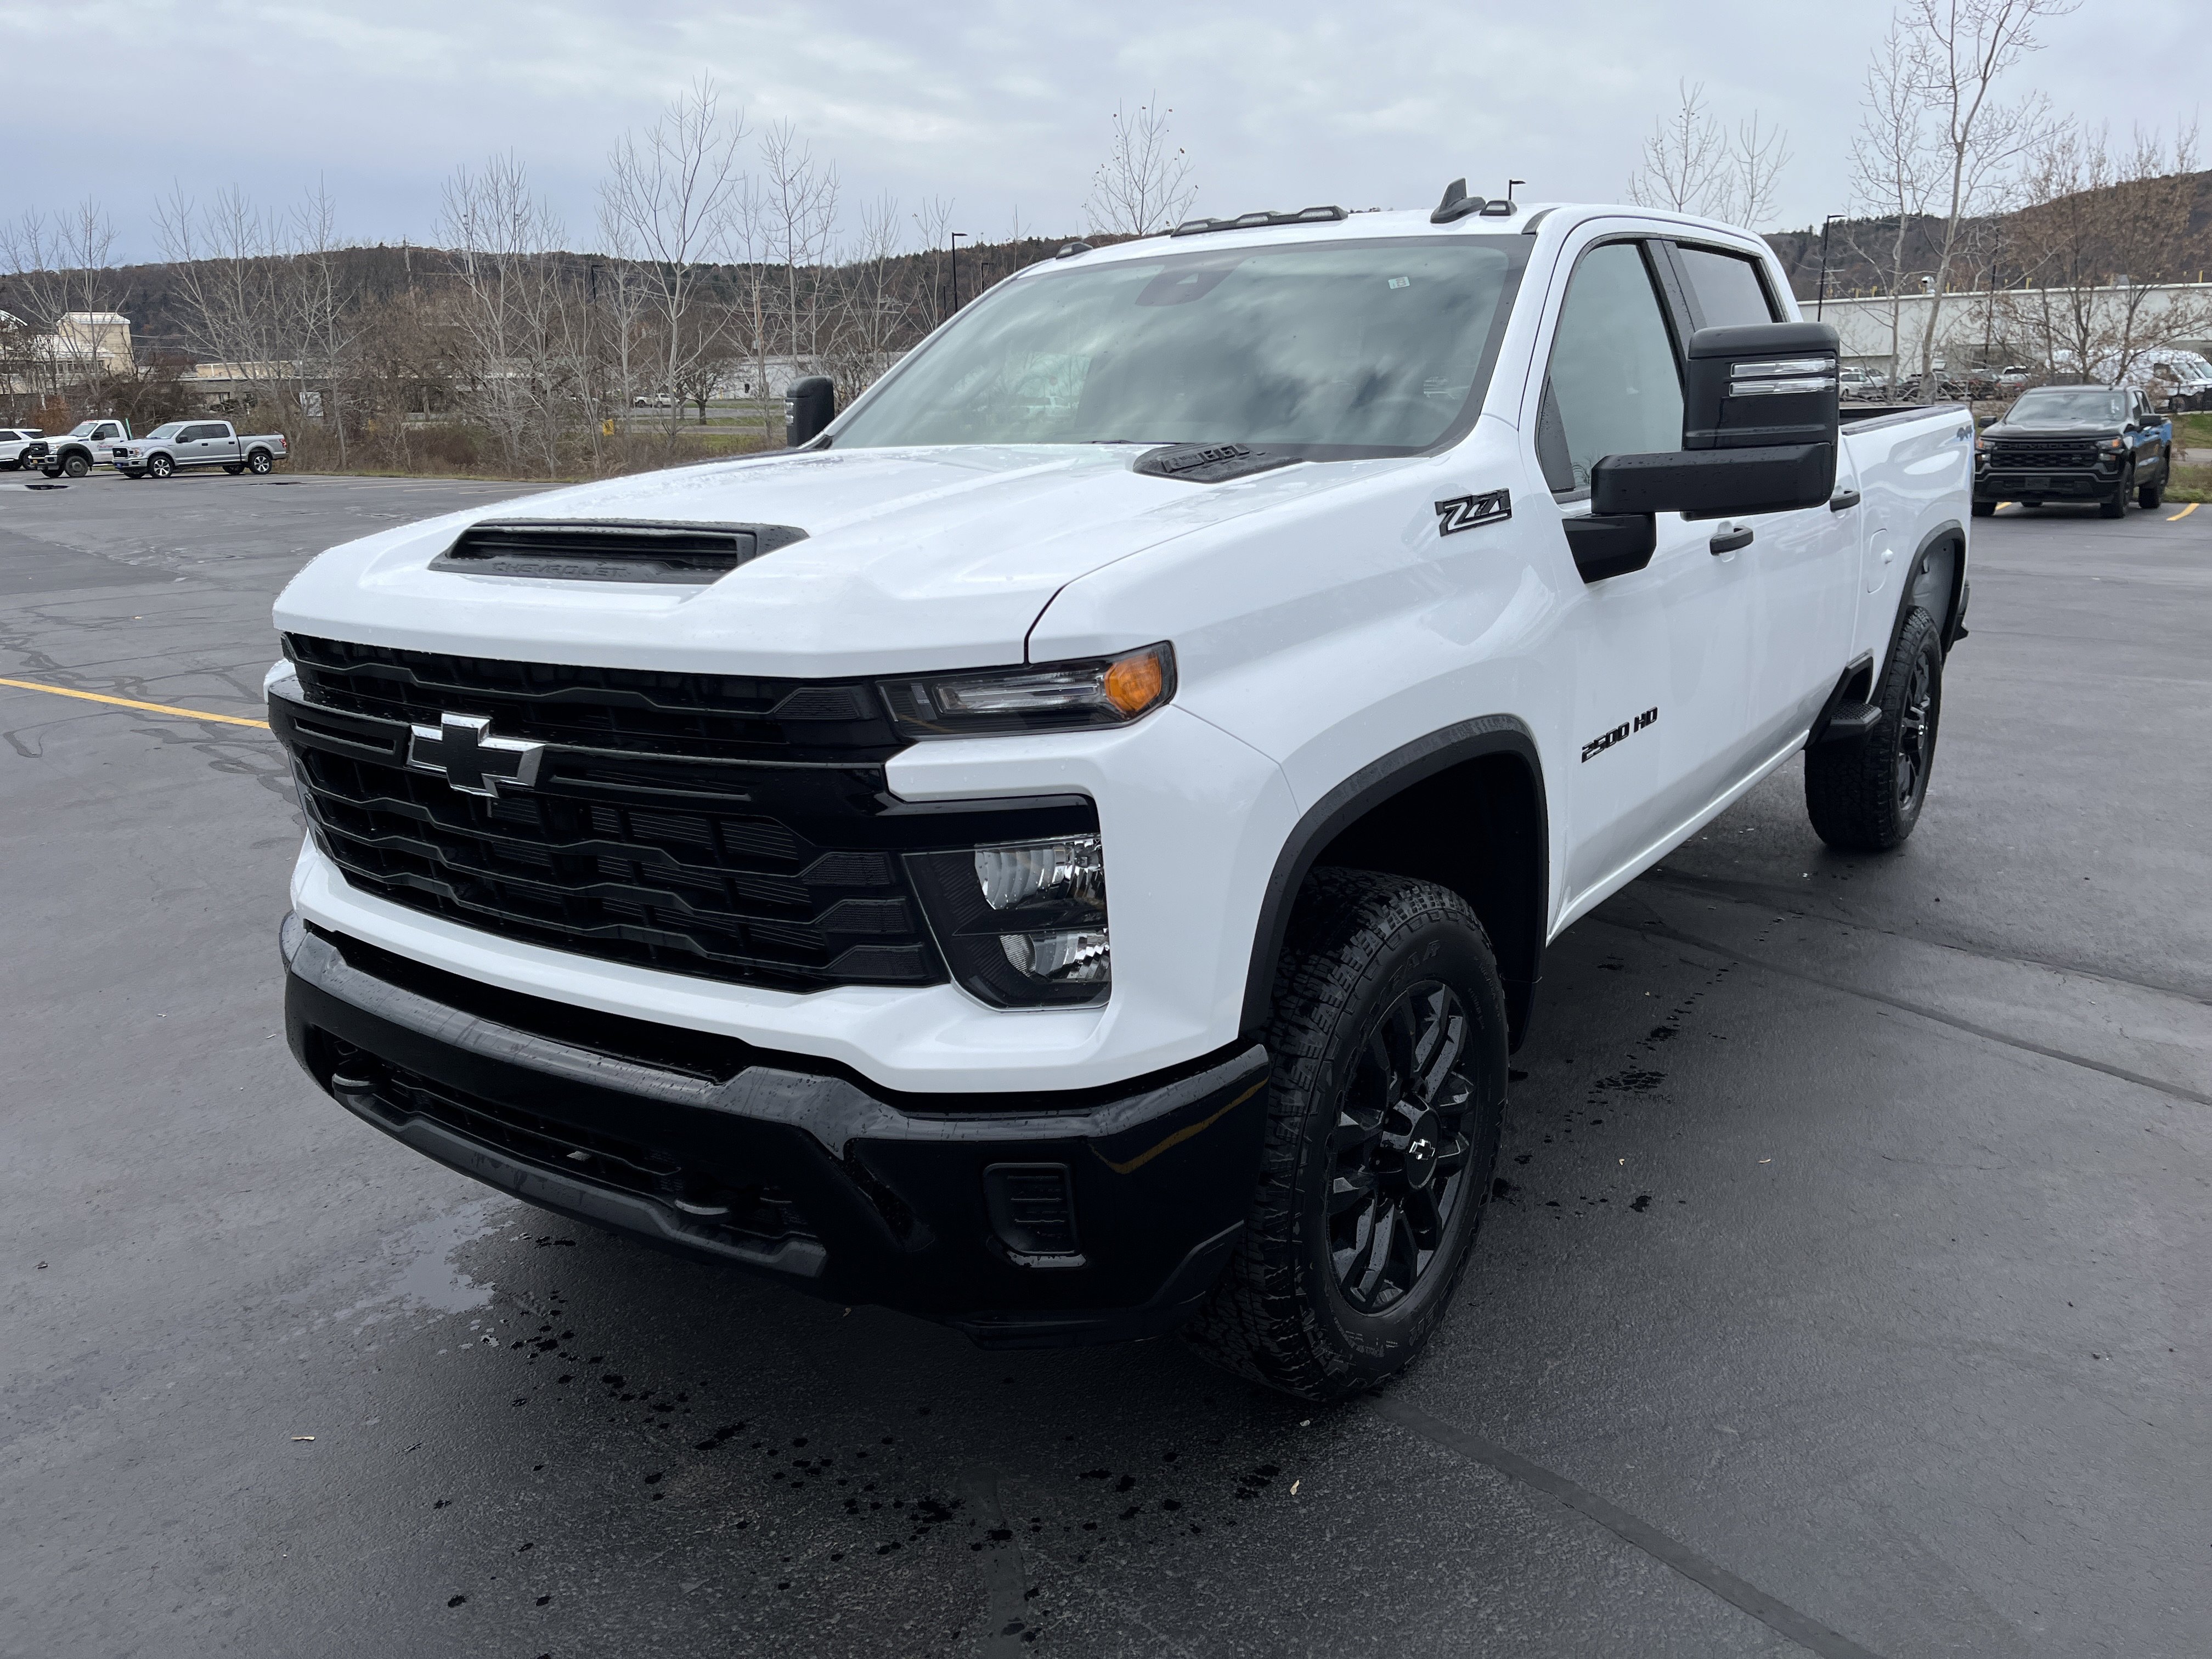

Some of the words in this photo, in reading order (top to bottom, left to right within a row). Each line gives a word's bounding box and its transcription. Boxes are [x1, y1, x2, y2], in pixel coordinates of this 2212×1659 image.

[1435, 487, 1513, 537] Z71
[493, 561, 628, 577] CHEVROLET
[1581, 721, 1630, 763] 2500
[1633, 706, 1658, 733] HD
